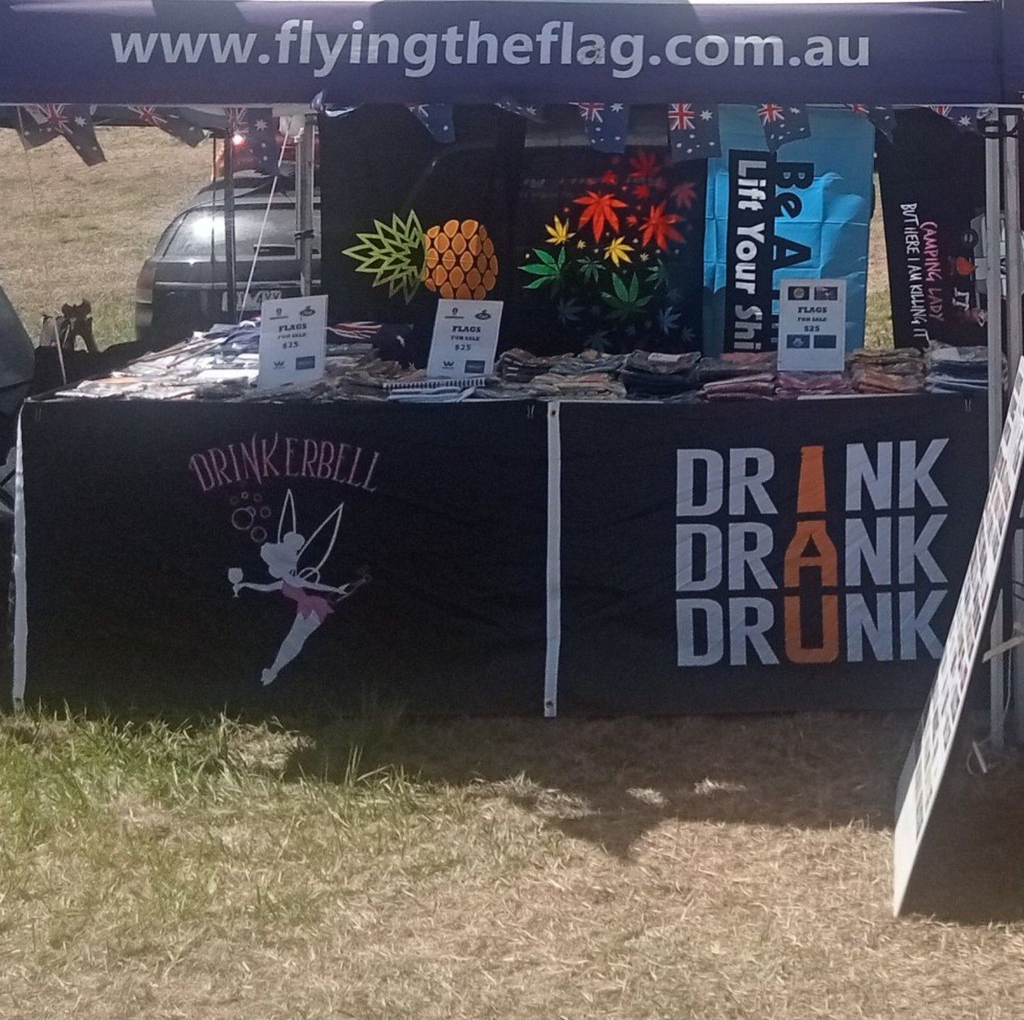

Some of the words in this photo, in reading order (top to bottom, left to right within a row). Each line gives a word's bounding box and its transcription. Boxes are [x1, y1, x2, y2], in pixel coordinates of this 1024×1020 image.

[111, 19, 870, 79] www.flyingtheflag.com.au
[737, 159, 767, 211] Lift
[774, 162, 815, 218] Be
[900, 202, 919, 225] BUT
[735, 222, 765, 295] Your
[904, 226, 921, 254] HERE
[920, 221, 942, 282] CAMPING
[908, 264, 922, 281] AM
[279, 323, 307, 333] FLAGS
[733, 304, 763, 351] Shi
[798, 306, 827, 314] FLAGS
[909, 284, 927, 324] KILLING
[928, 287, 944, 321] LADY
[452, 325, 482, 333] FLAGS
[188, 432, 384, 493] DRINKERBELL
[676, 438, 950, 516] DRINK
[675, 513, 949, 592] DRANK
[675, 589, 949, 666] DRUNK
